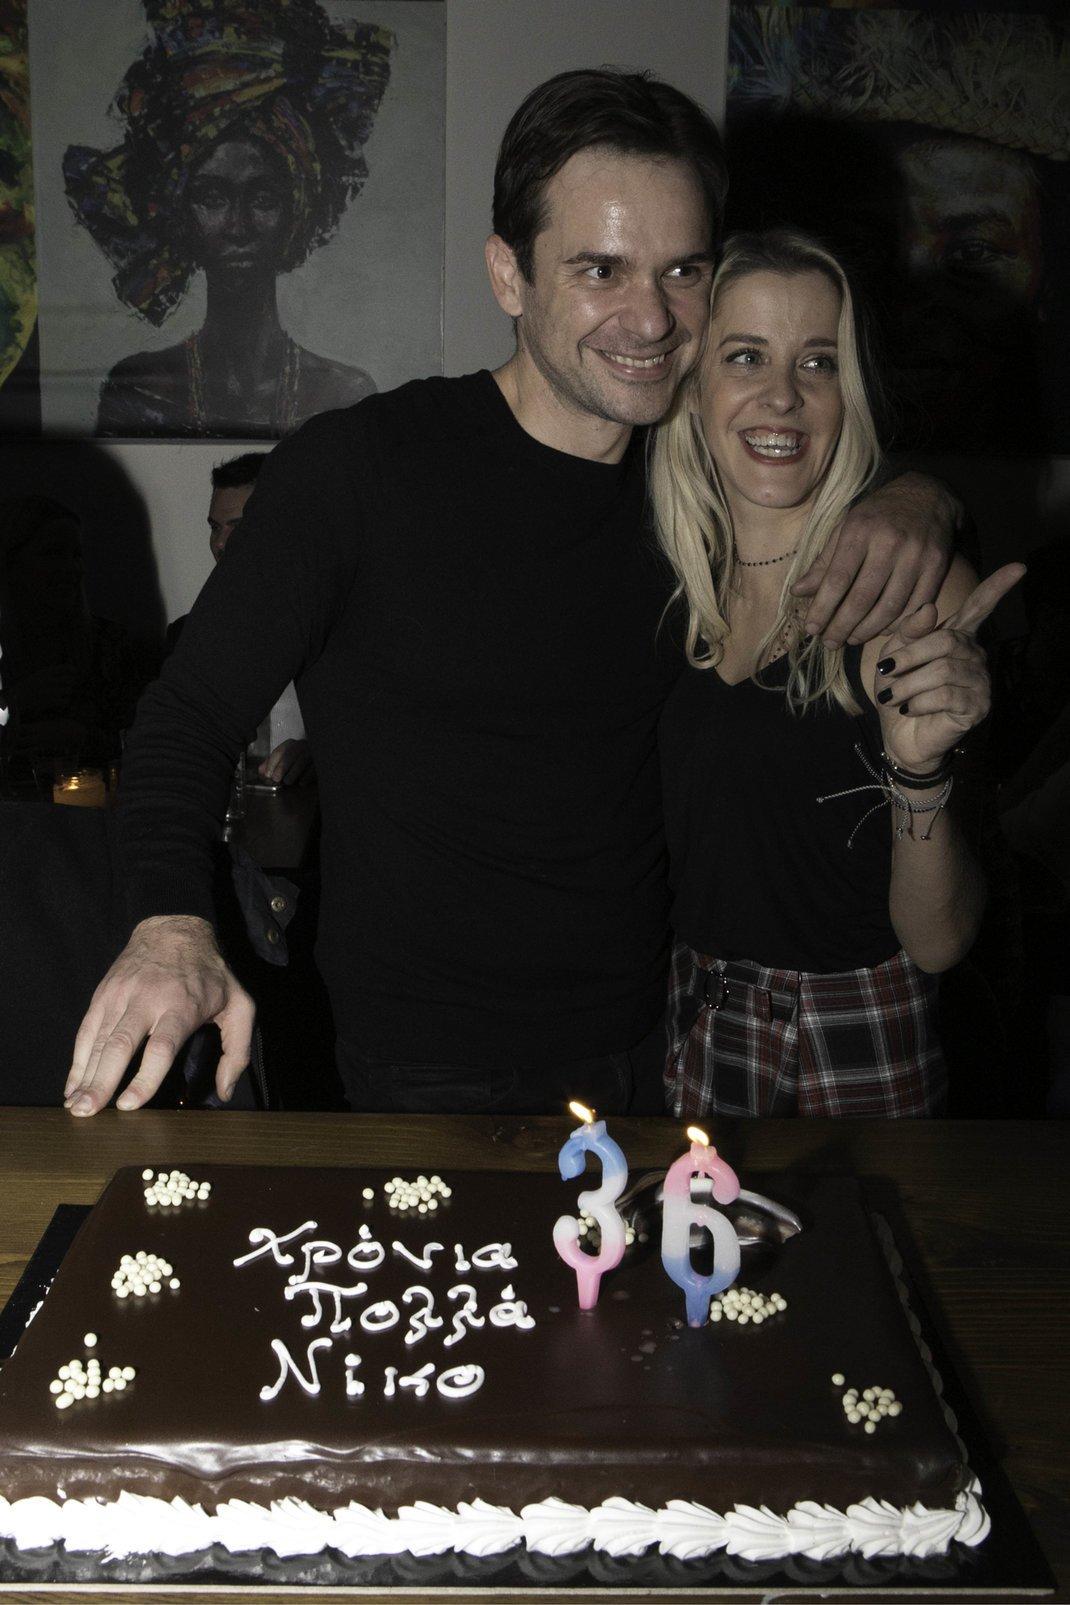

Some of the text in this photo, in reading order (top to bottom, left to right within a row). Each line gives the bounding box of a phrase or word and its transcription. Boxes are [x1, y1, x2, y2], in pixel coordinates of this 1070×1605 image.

[553, 1121, 741, 1298] 36
[233, 1220, 519, 1284] Χρόνια
[284, 1281, 536, 1346] Πολλά
